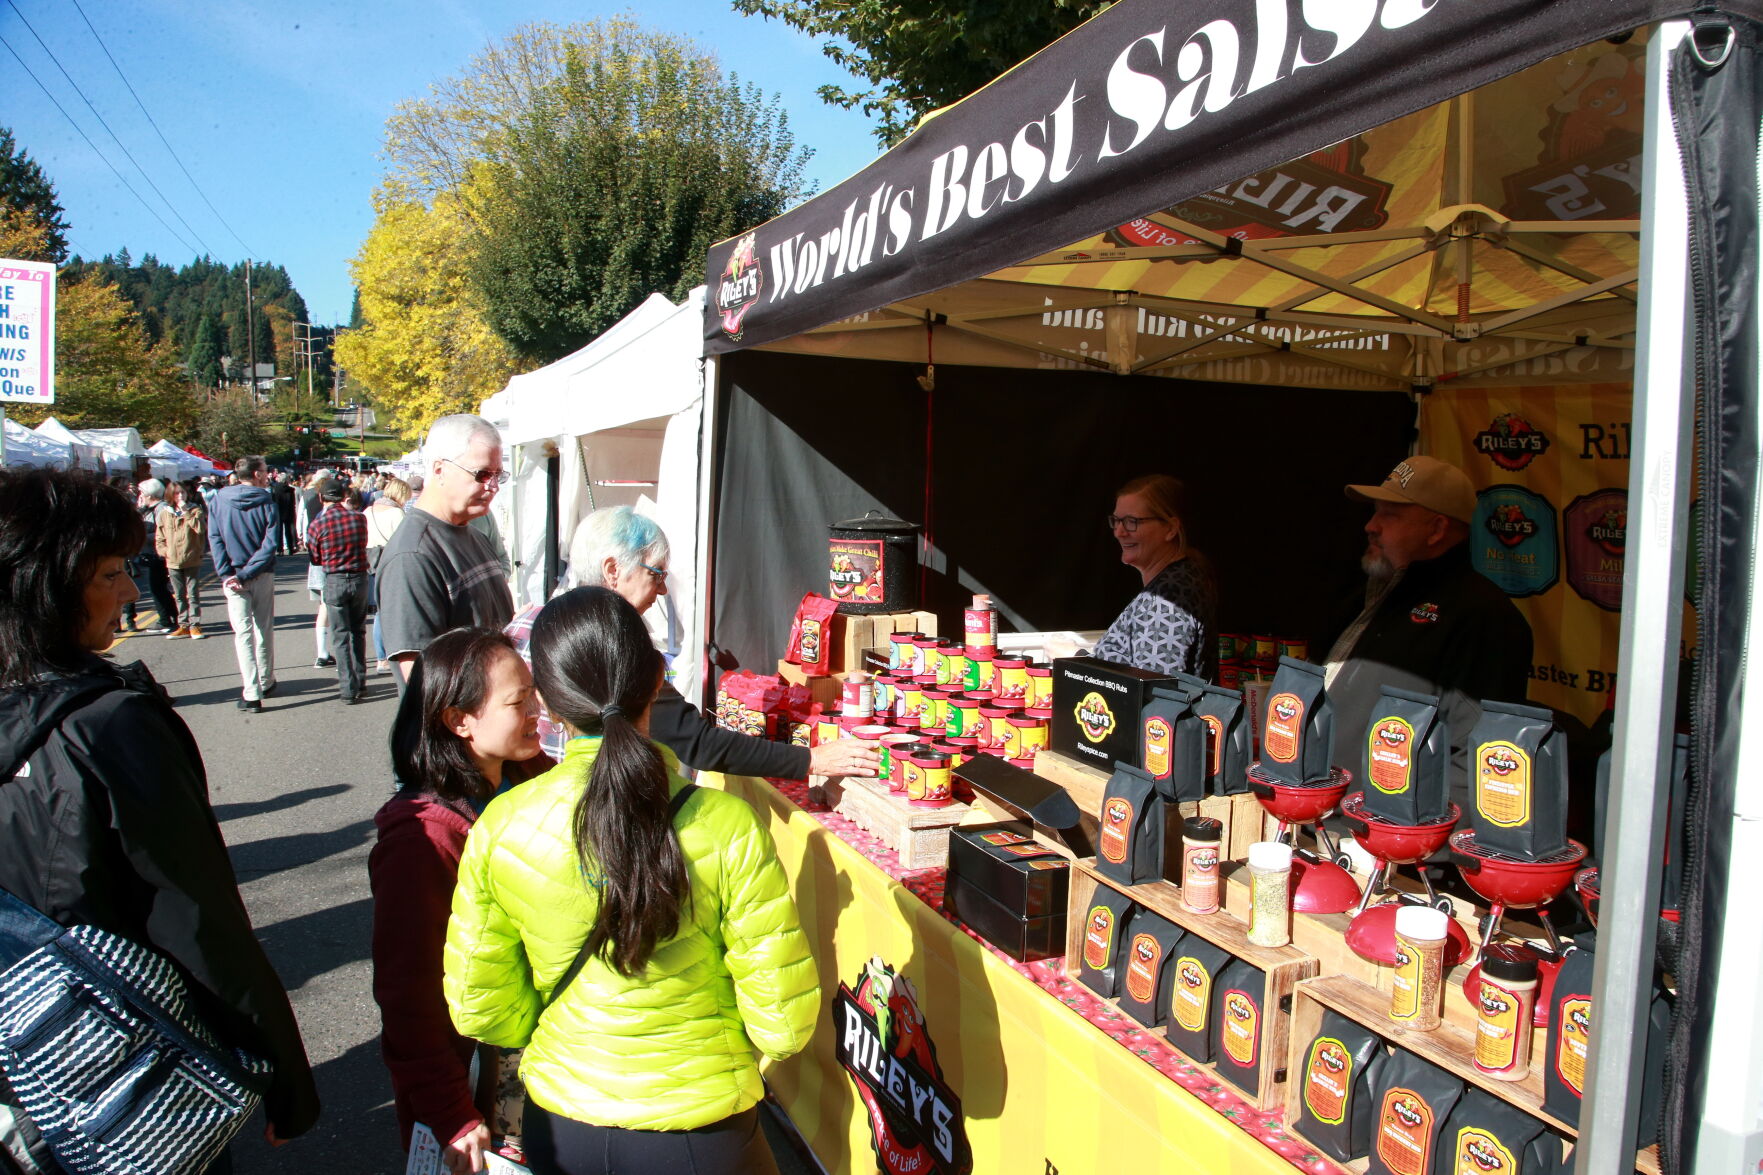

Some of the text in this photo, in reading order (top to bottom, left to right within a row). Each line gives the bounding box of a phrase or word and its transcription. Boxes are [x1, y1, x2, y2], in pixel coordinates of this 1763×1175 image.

[770, 181, 914, 303] World's
[918, 78, 1087, 243] Best
[28, 270, 44, 281] To
[720, 268, 757, 307] RILEY'S
[2, 380, 35, 397] Que
[1481, 434, 1542, 450] RILEY'S
[1490, 520, 1533, 533] RILEY'S
[1064, 669, 1128, 693] Pitmaster Collection BBQ Rubs
[1080, 708, 1110, 727] RILEY'S
[1381, 730, 1405, 742] RILEY'S
[1488, 757, 1517, 769] RILEY'S
[1321, 1051, 1344, 1070] RILEY'S
[843, 1000, 953, 1164] RILEY'S
[1395, 1102, 1422, 1124] RILEY'S
[900, 1152, 922, 1172] Life!
[1469, 1144, 1500, 1168] RILEY'S
